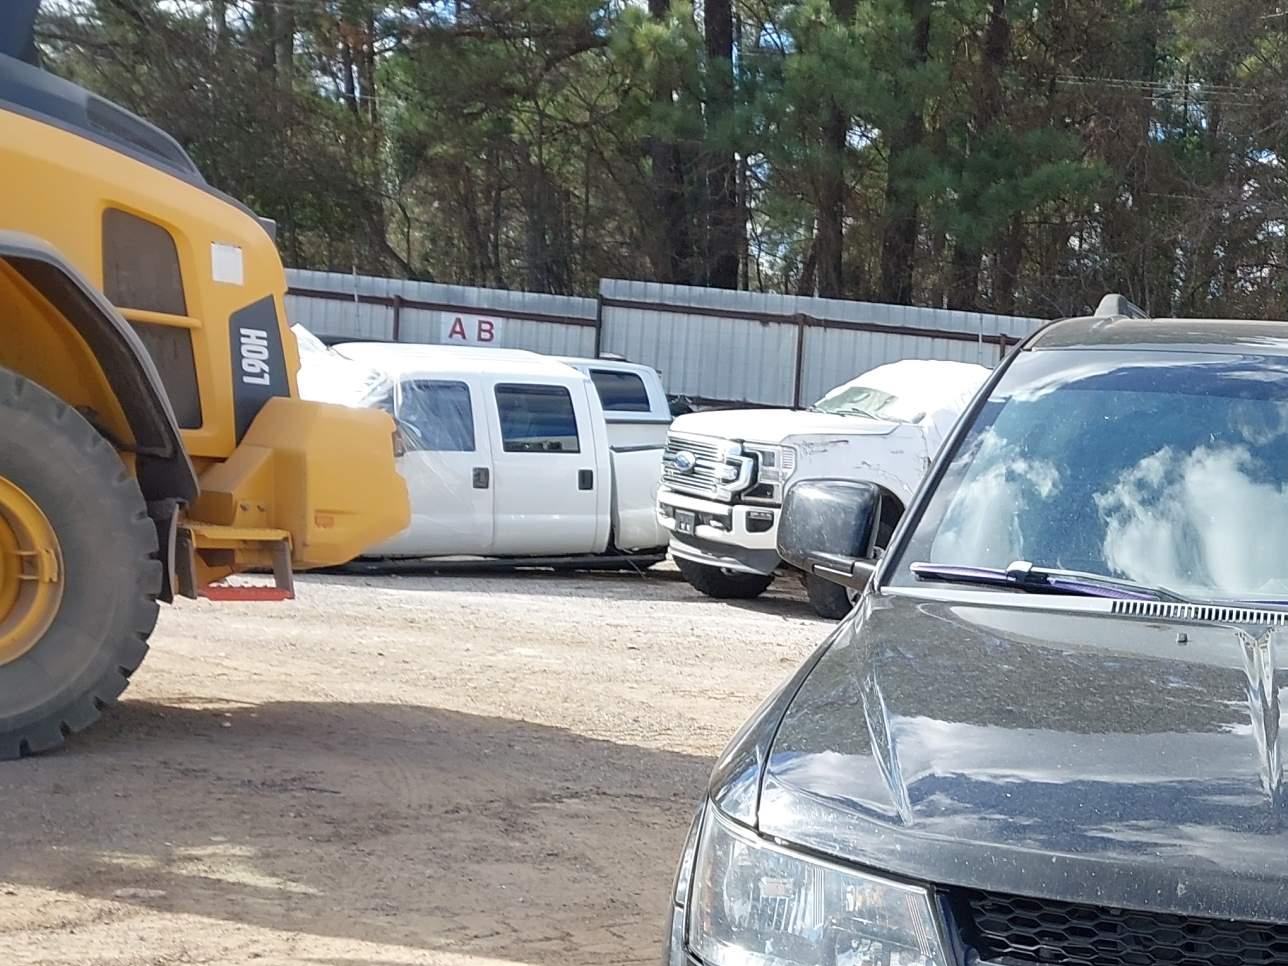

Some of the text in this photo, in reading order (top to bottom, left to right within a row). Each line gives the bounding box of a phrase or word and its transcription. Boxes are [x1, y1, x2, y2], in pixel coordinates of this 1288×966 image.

[447, 316, 496, 342] A B
[238, 326, 272, 386] L90H
